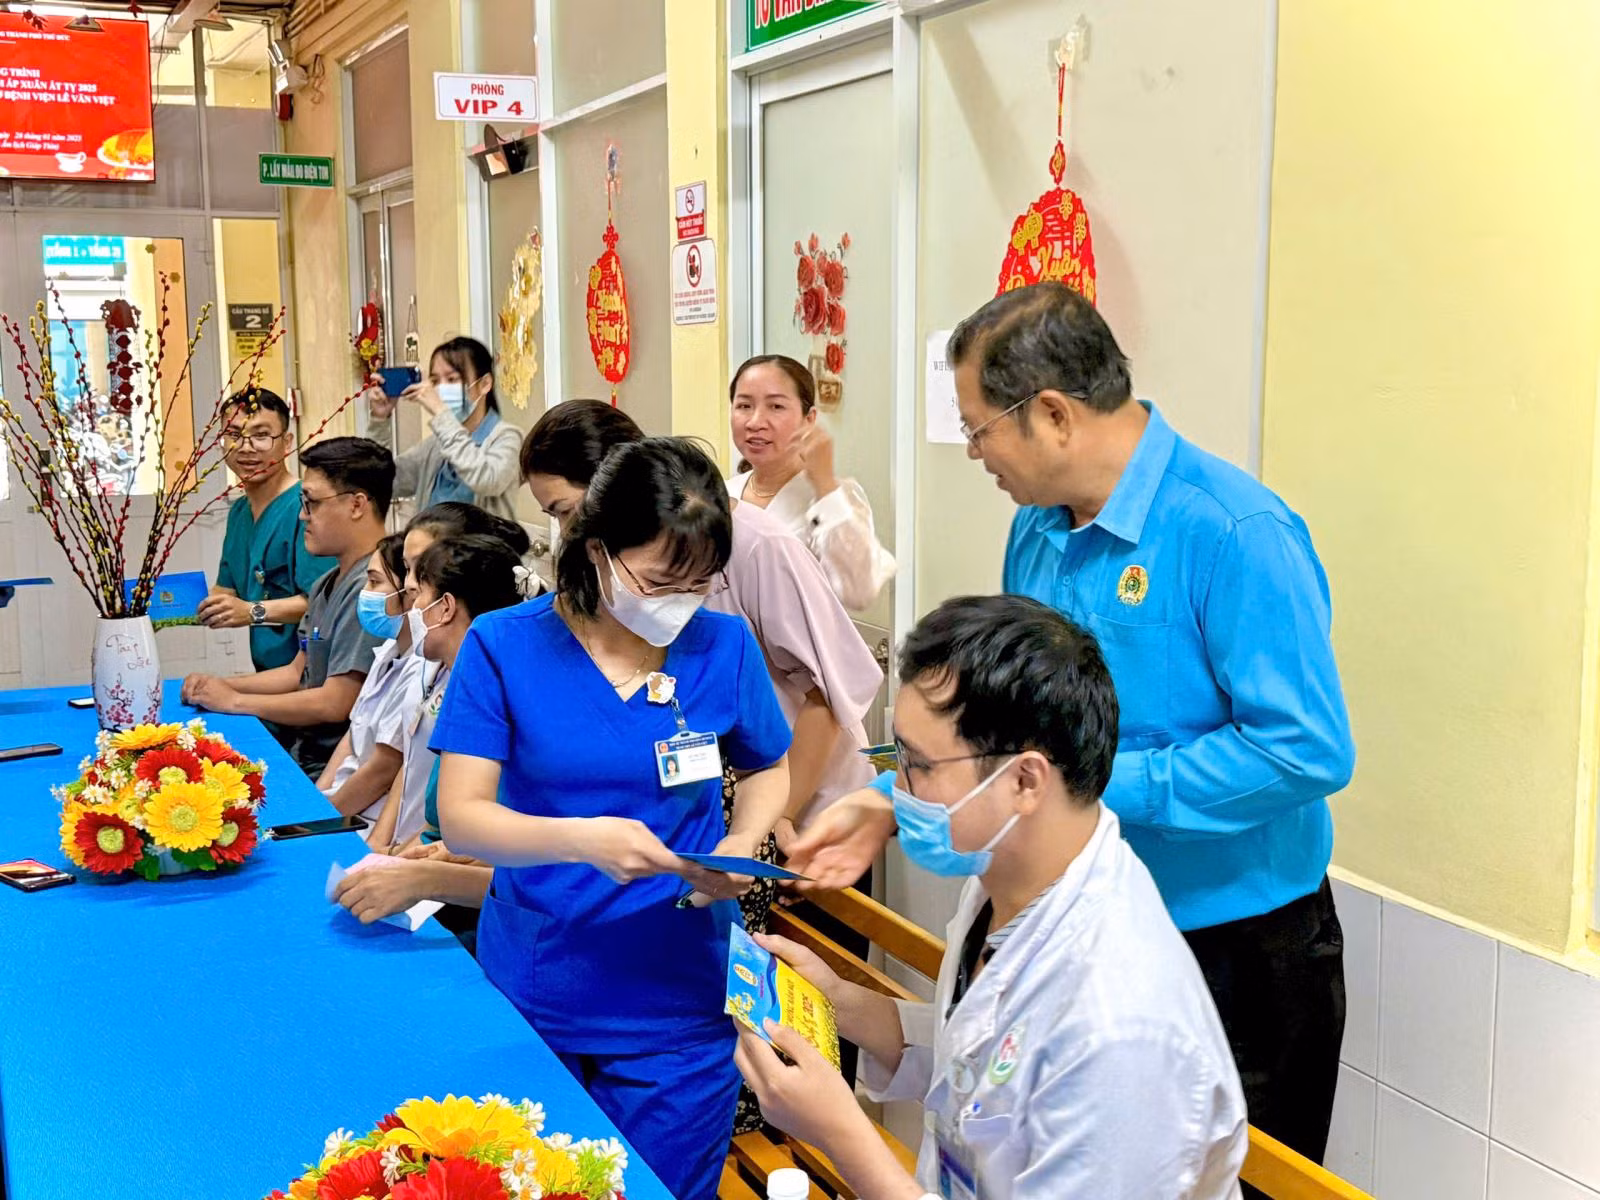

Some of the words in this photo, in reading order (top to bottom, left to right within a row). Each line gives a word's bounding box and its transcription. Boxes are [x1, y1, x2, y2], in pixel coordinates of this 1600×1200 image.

[9, 67, 40, 78] TRÌNH
[20, 79, 47, 89] XUÂN
[470, 81, 505, 96] PHÒNG
[32, 91, 56, 103] VIỆN
[57, 92, 70, 102] LÊ
[71, 94, 93, 104] VĂN
[93, 95, 116, 106] VIỆT
[454, 99, 498, 114] VIP
[507, 101, 524, 115] 4
[245, 315, 262, 328] 2
